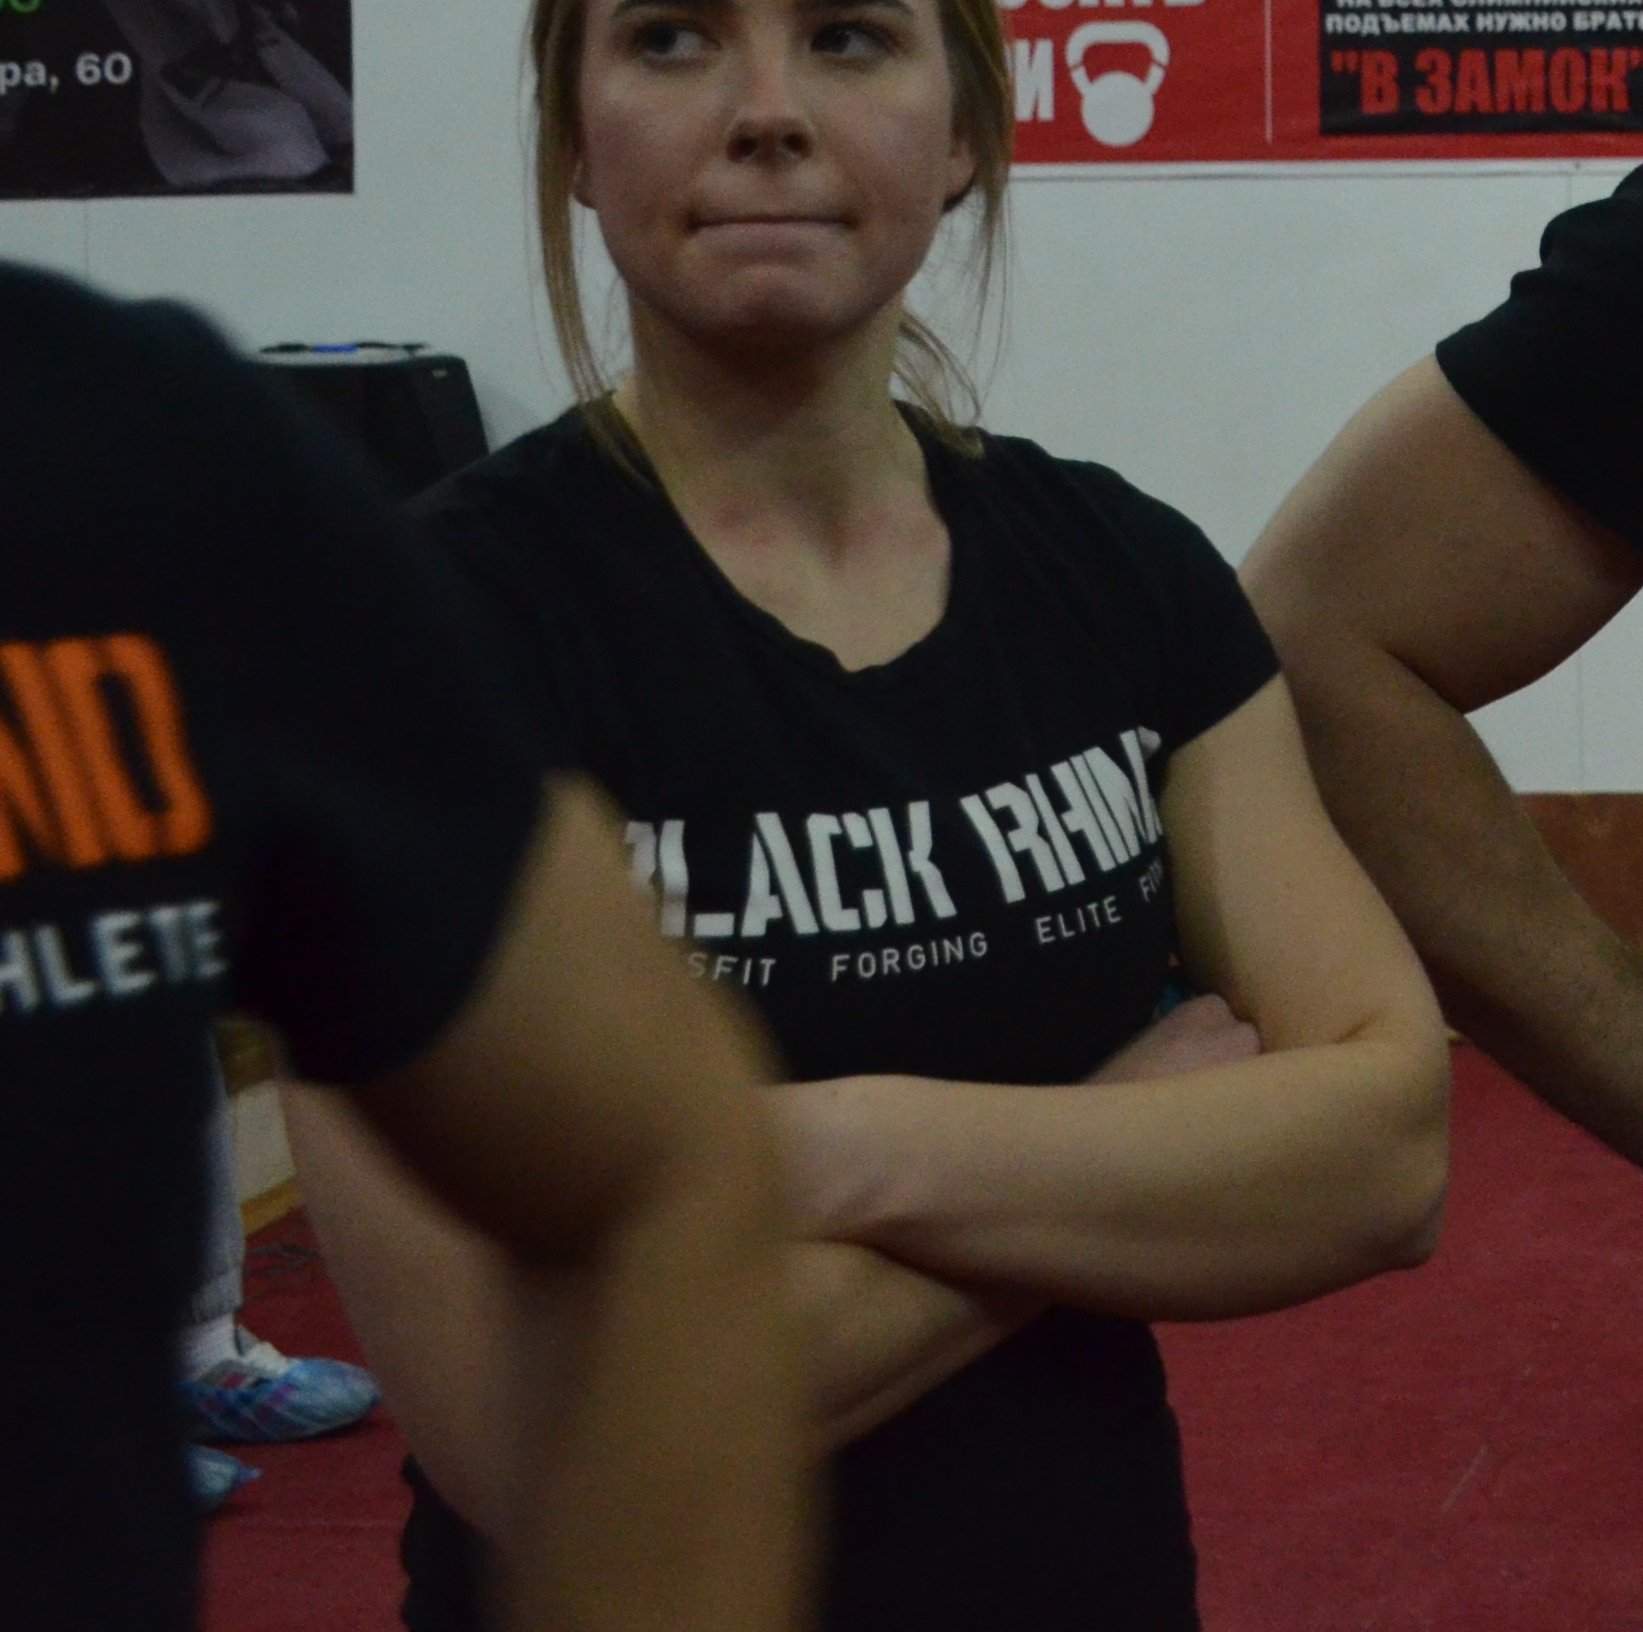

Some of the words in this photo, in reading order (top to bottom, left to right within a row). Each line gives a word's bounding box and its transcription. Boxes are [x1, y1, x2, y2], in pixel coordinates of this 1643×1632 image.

[1325, 11, 1471, 39] ПОДЪЕМАХ
[1477, 10, 1566, 35] НУЖНО
[75, 52, 131, 86] 60
[1331, 47, 1401, 118] "В
[960, 725, 1165, 904] RHIN
[0, 898, 231, 1015] HLETE
[829, 930, 989, 983] FORGING
[1035, 895, 1122, 946] ELITE
